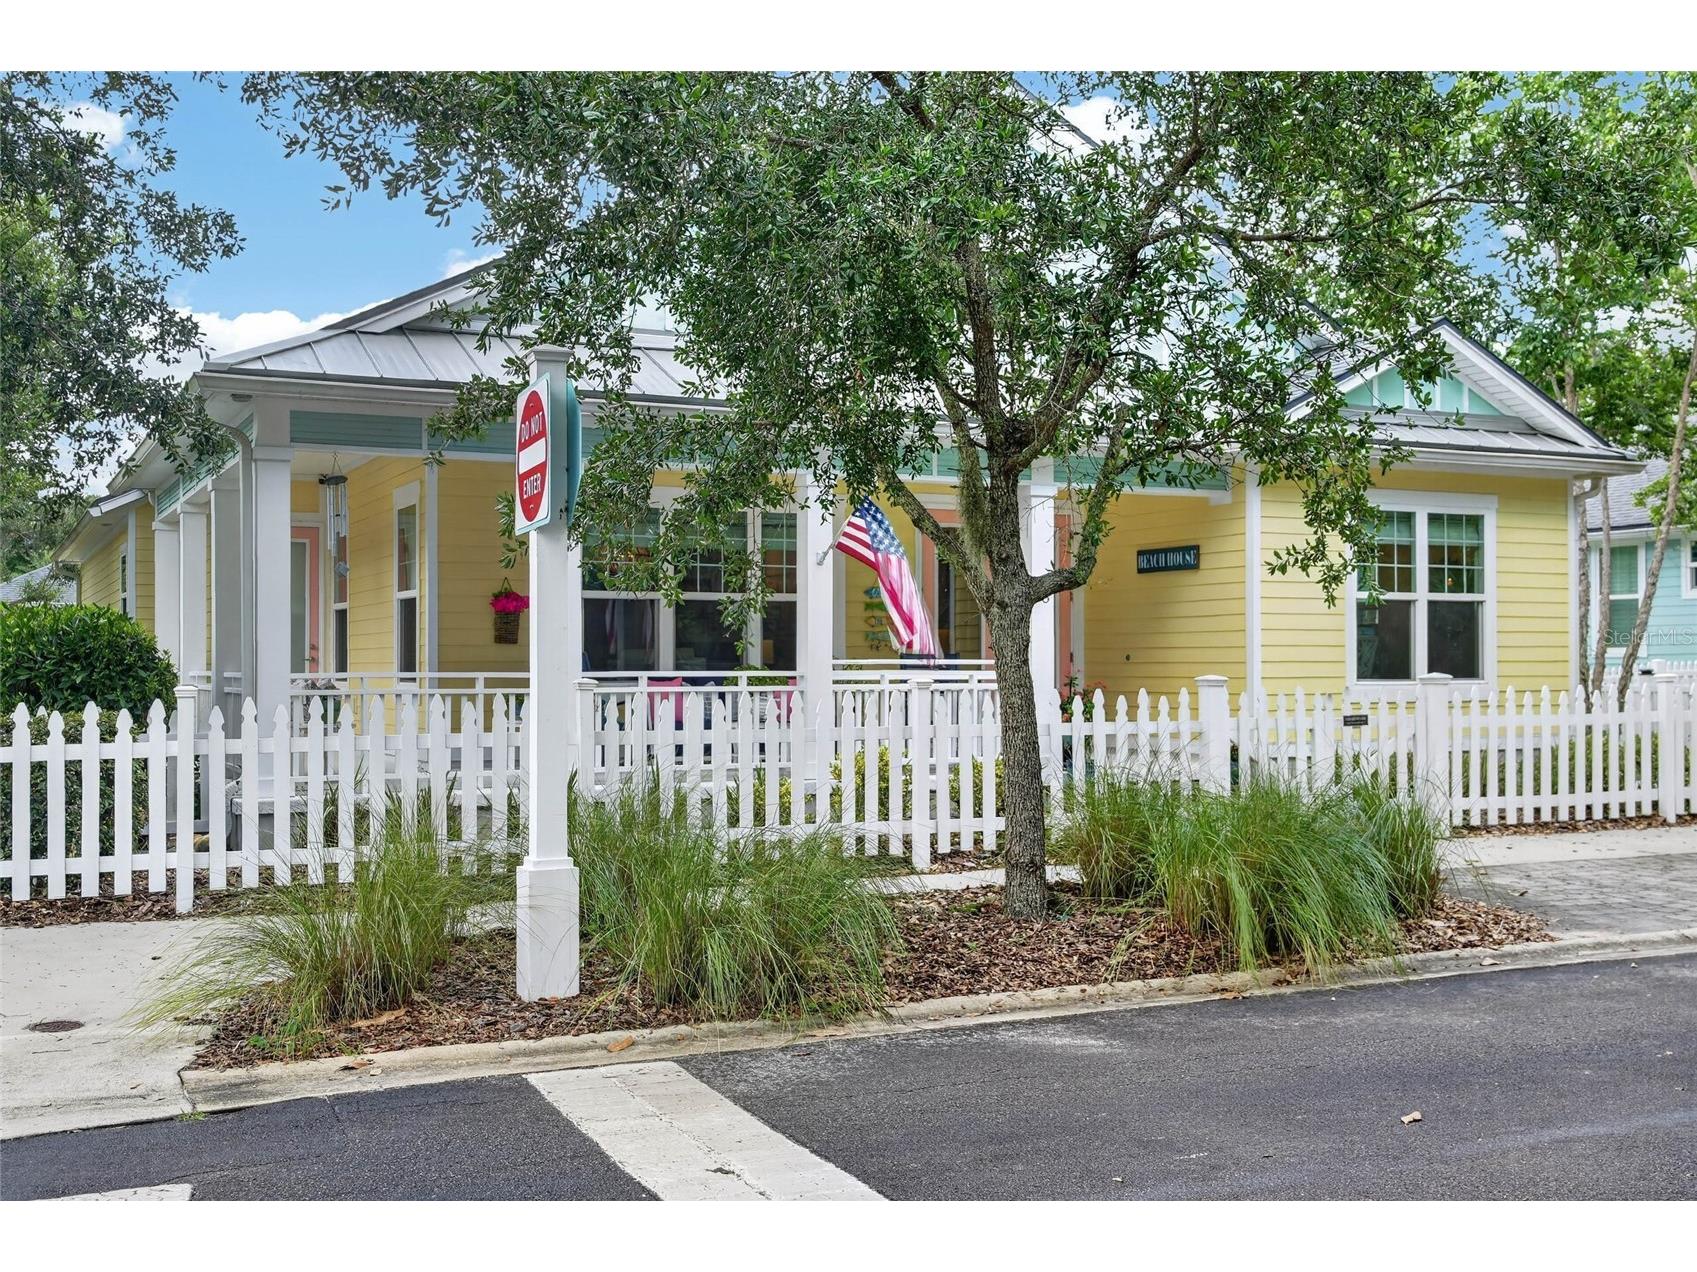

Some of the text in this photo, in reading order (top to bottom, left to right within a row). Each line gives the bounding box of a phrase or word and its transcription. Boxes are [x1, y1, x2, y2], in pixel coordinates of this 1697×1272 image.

[521, 412, 543, 443] DO NOT
[523, 473, 541, 499] ENTER
[1138, 549, 1197, 569] BEACH HOUSE
